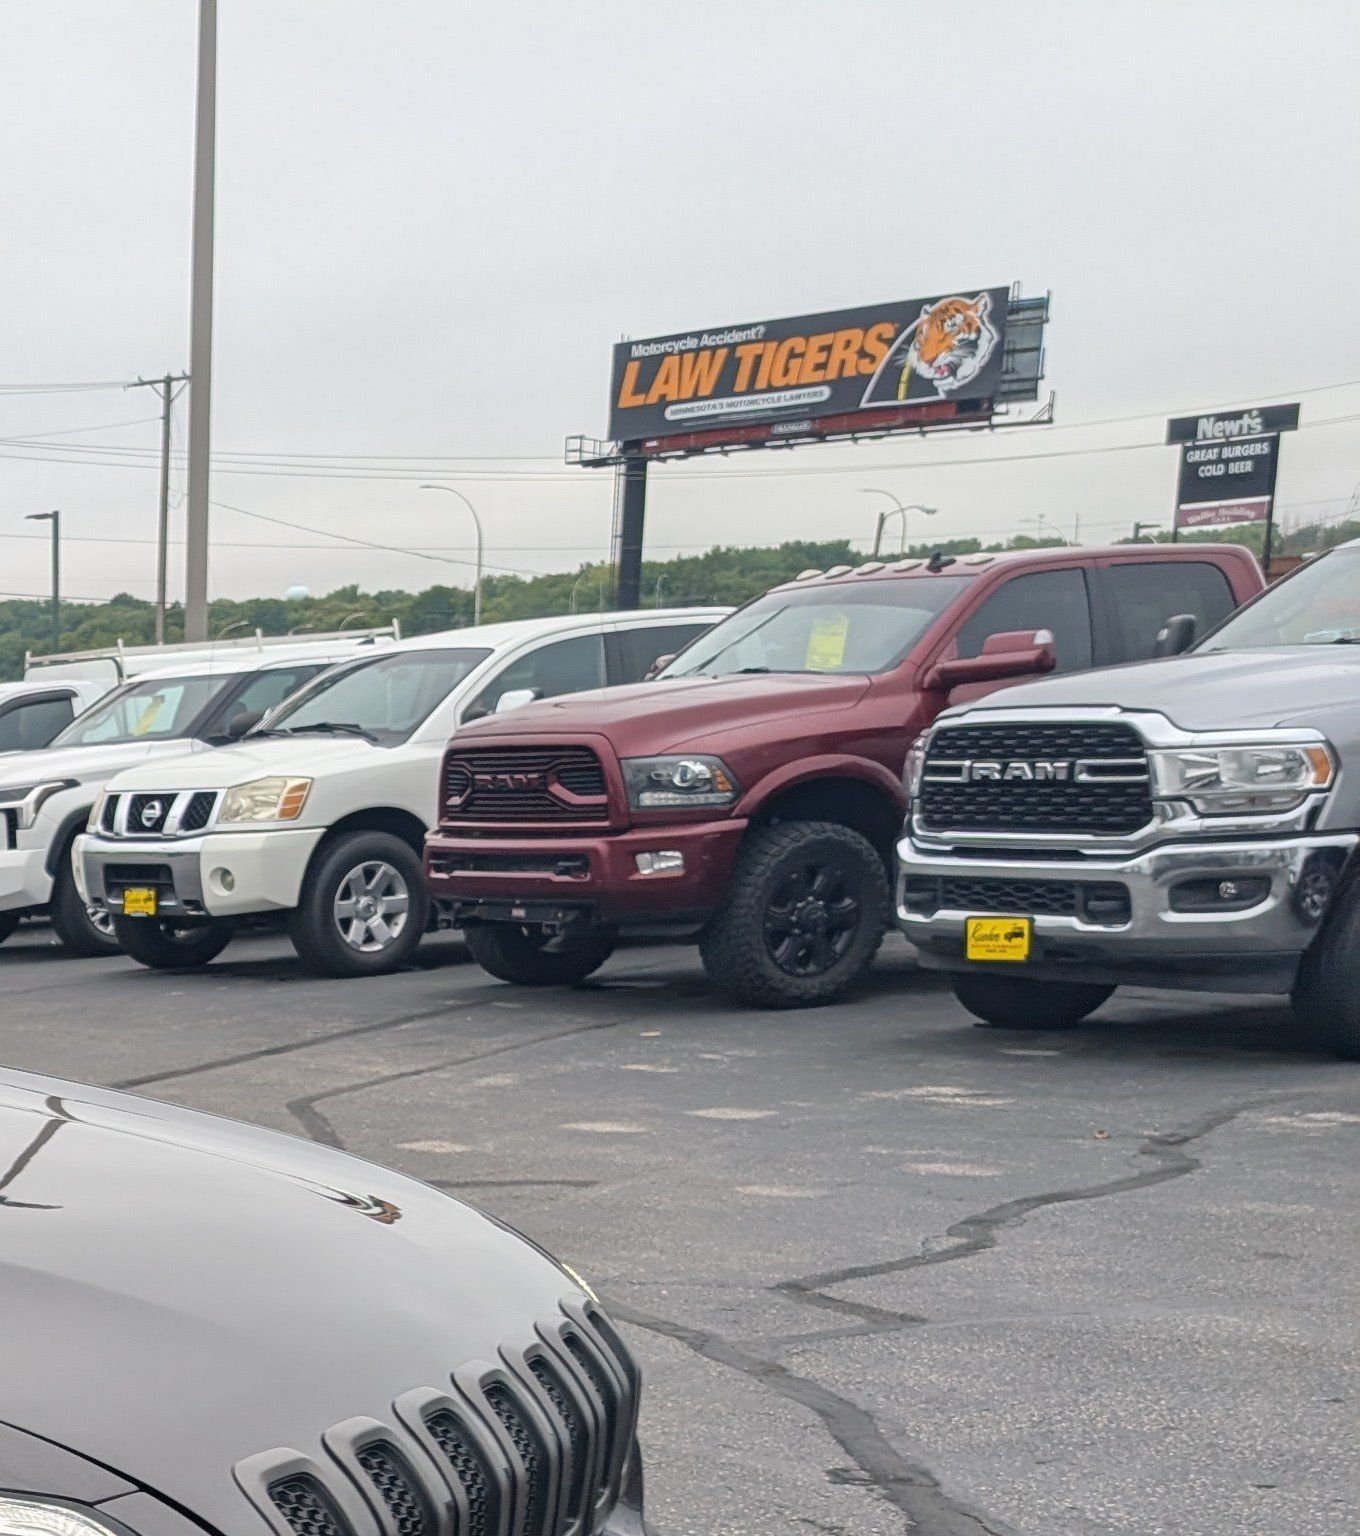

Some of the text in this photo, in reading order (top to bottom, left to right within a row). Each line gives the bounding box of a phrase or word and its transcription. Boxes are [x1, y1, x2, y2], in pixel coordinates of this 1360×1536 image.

[630, 325, 764, 358] Motorcycle Accident?
[617, 321, 897, 409] LAW TIGERS
[1197, 409, 1262, 439] Newt's
[1186, 443, 1269, 463] GREAT BURGERS
[1198, 460, 1254, 478] COLD BEER
[972, 758, 1070, 782] RAM
